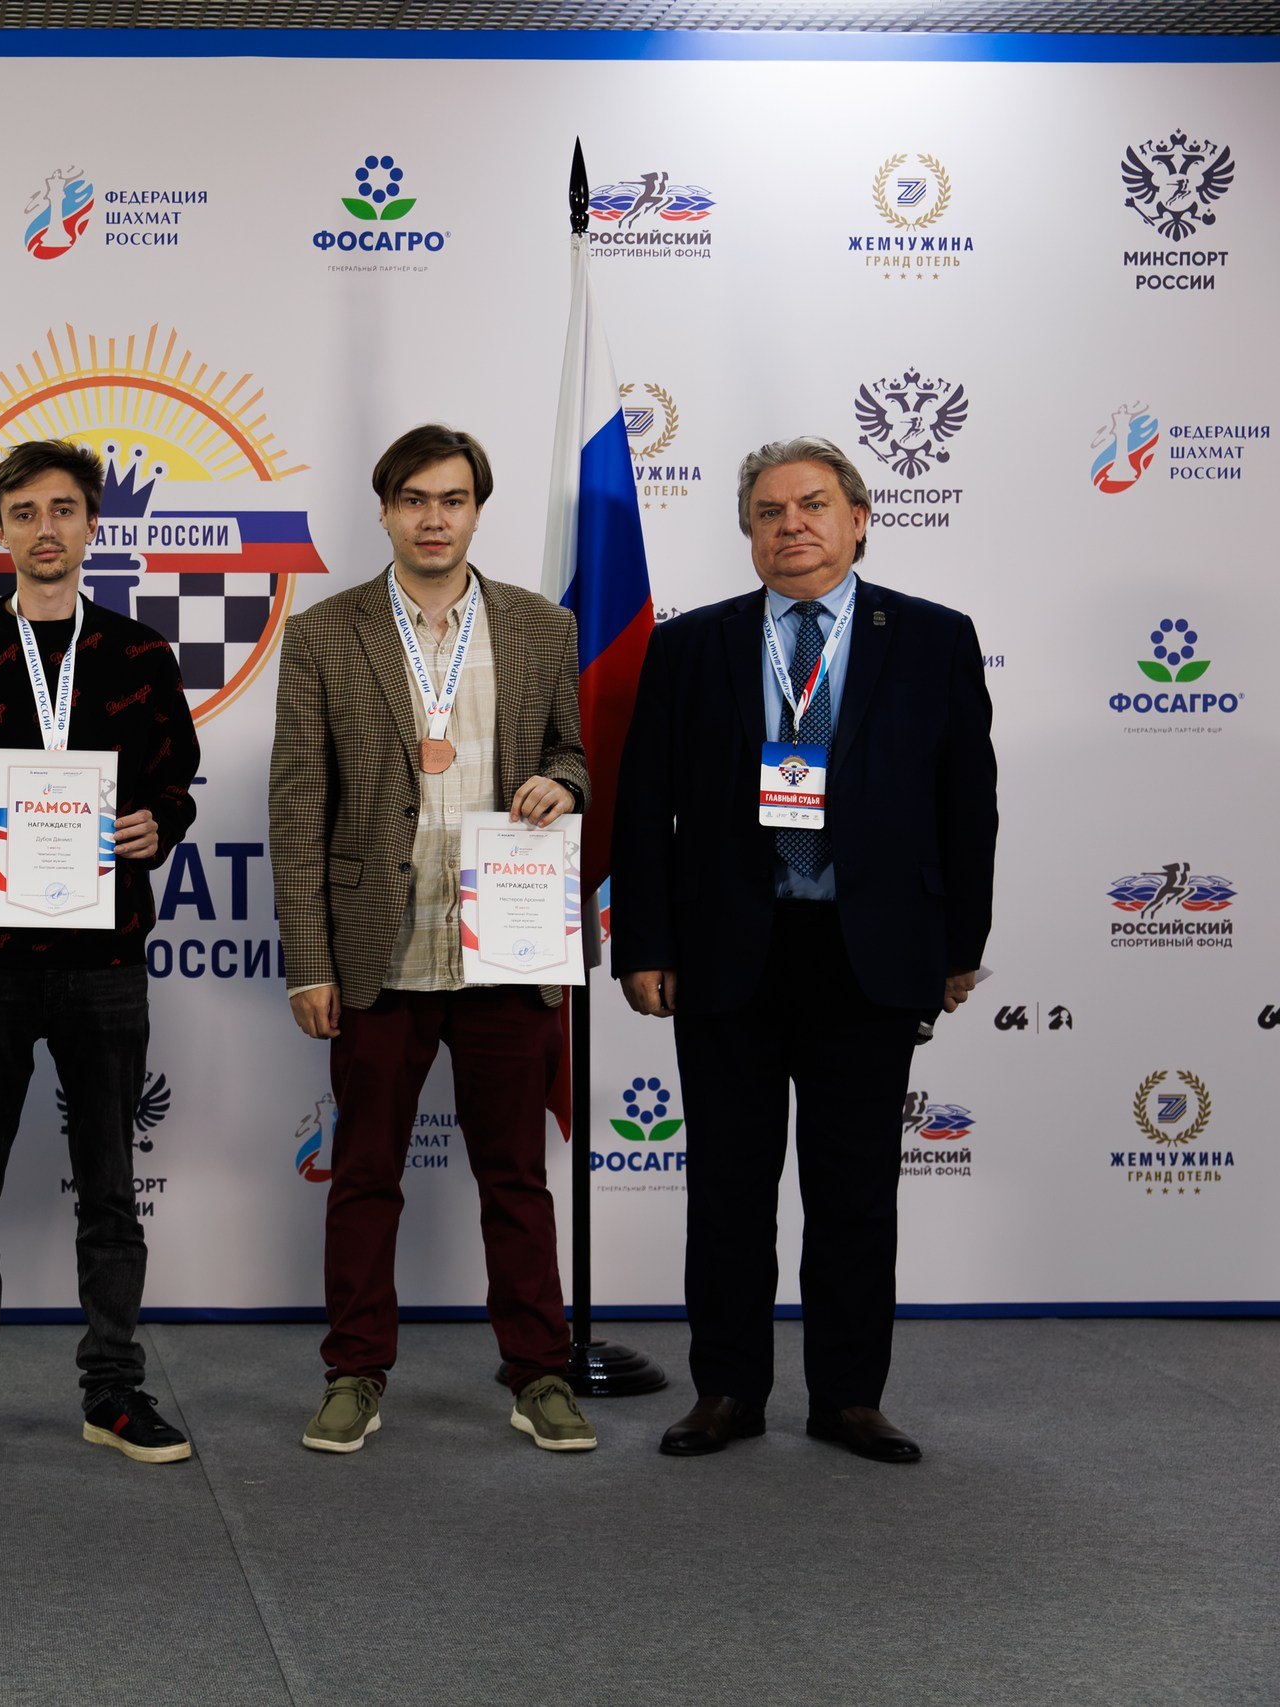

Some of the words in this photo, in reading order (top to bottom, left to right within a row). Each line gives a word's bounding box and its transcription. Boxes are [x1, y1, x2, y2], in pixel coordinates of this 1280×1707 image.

[105, 191, 207, 205] ФЕДЕРАЦИЯ
[106, 212, 181, 224] ШАХМАТ
[106, 233, 177, 245] РОССИИ
[589, 229, 711, 245] РОССИЙСКИЙ
[849, 237, 973, 251] ЖЕМЧУЖИНА
[590, 247, 671, 257] СПОРТИВНЫЙ
[675, 249, 710, 259] ФОНД
[1124, 251, 1228, 266] МИНСПОРТ
[866, 256, 910, 268] ГРАНД
[917, 256, 960, 266] ОТЕЛЬ
[1136, 275, 1214, 290] РОССИИ
[1170, 426, 1269, 439] ФЕДЕРАЦИЯ
[1171, 446, 1244, 458] ШАХМАТ
[636, 466, 701, 481] УЖИНА
[1171, 467, 1240, 479] РОССИИ
[644, 485, 688, 496] ОТЕЛЬ
[869, 489, 962, 503] ИНСПОРТ
[870, 513, 949, 527] РОССИИ
[148, 525, 228, 546] РОССИИ
[63, 638, 74, 672] ШАХ
[399, 618, 418, 654] ШАХМАТ
[413, 656, 430, 693] РОССИИ
[446, 645, 465, 695] ФЕДЕРАЦИЯ
[460, 607, 475, 643] ШАХМАТ
[27, 649, 43, 687] ШАХМАТ
[38, 690, 52, 730] РОССИИ
[58, 675, 70, 731] ФЕДЕРАЦИЯ
[765, 793, 797, 803] ГЛАВНЫЙ
[798, 796, 820, 805] СУДЬЯ
[15, 800, 92, 815] ГРАМОТА
[484, 862, 557, 876] ГРАМОТА
[1112, 919, 1232, 935] РОССИЙСКИЙ
[1111, 937, 1193, 947] СПОРТИВНЫЙ
[1197, 938, 1232, 948] ФОНД
[147, 939, 285, 979] ОССИ
[590, 1151, 686, 1172] ФОСАГР
[900, 1148, 971, 1164] ИЙСКИЙ
[1111, 1152, 1234, 1166] ЖЕМЧУЖИНА
[935, 1167, 971, 1176] ФОНД
[1128, 1171, 1172, 1183] ГРАНД
[1178, 1170, 1221, 1182] ОТЕЛЬ
